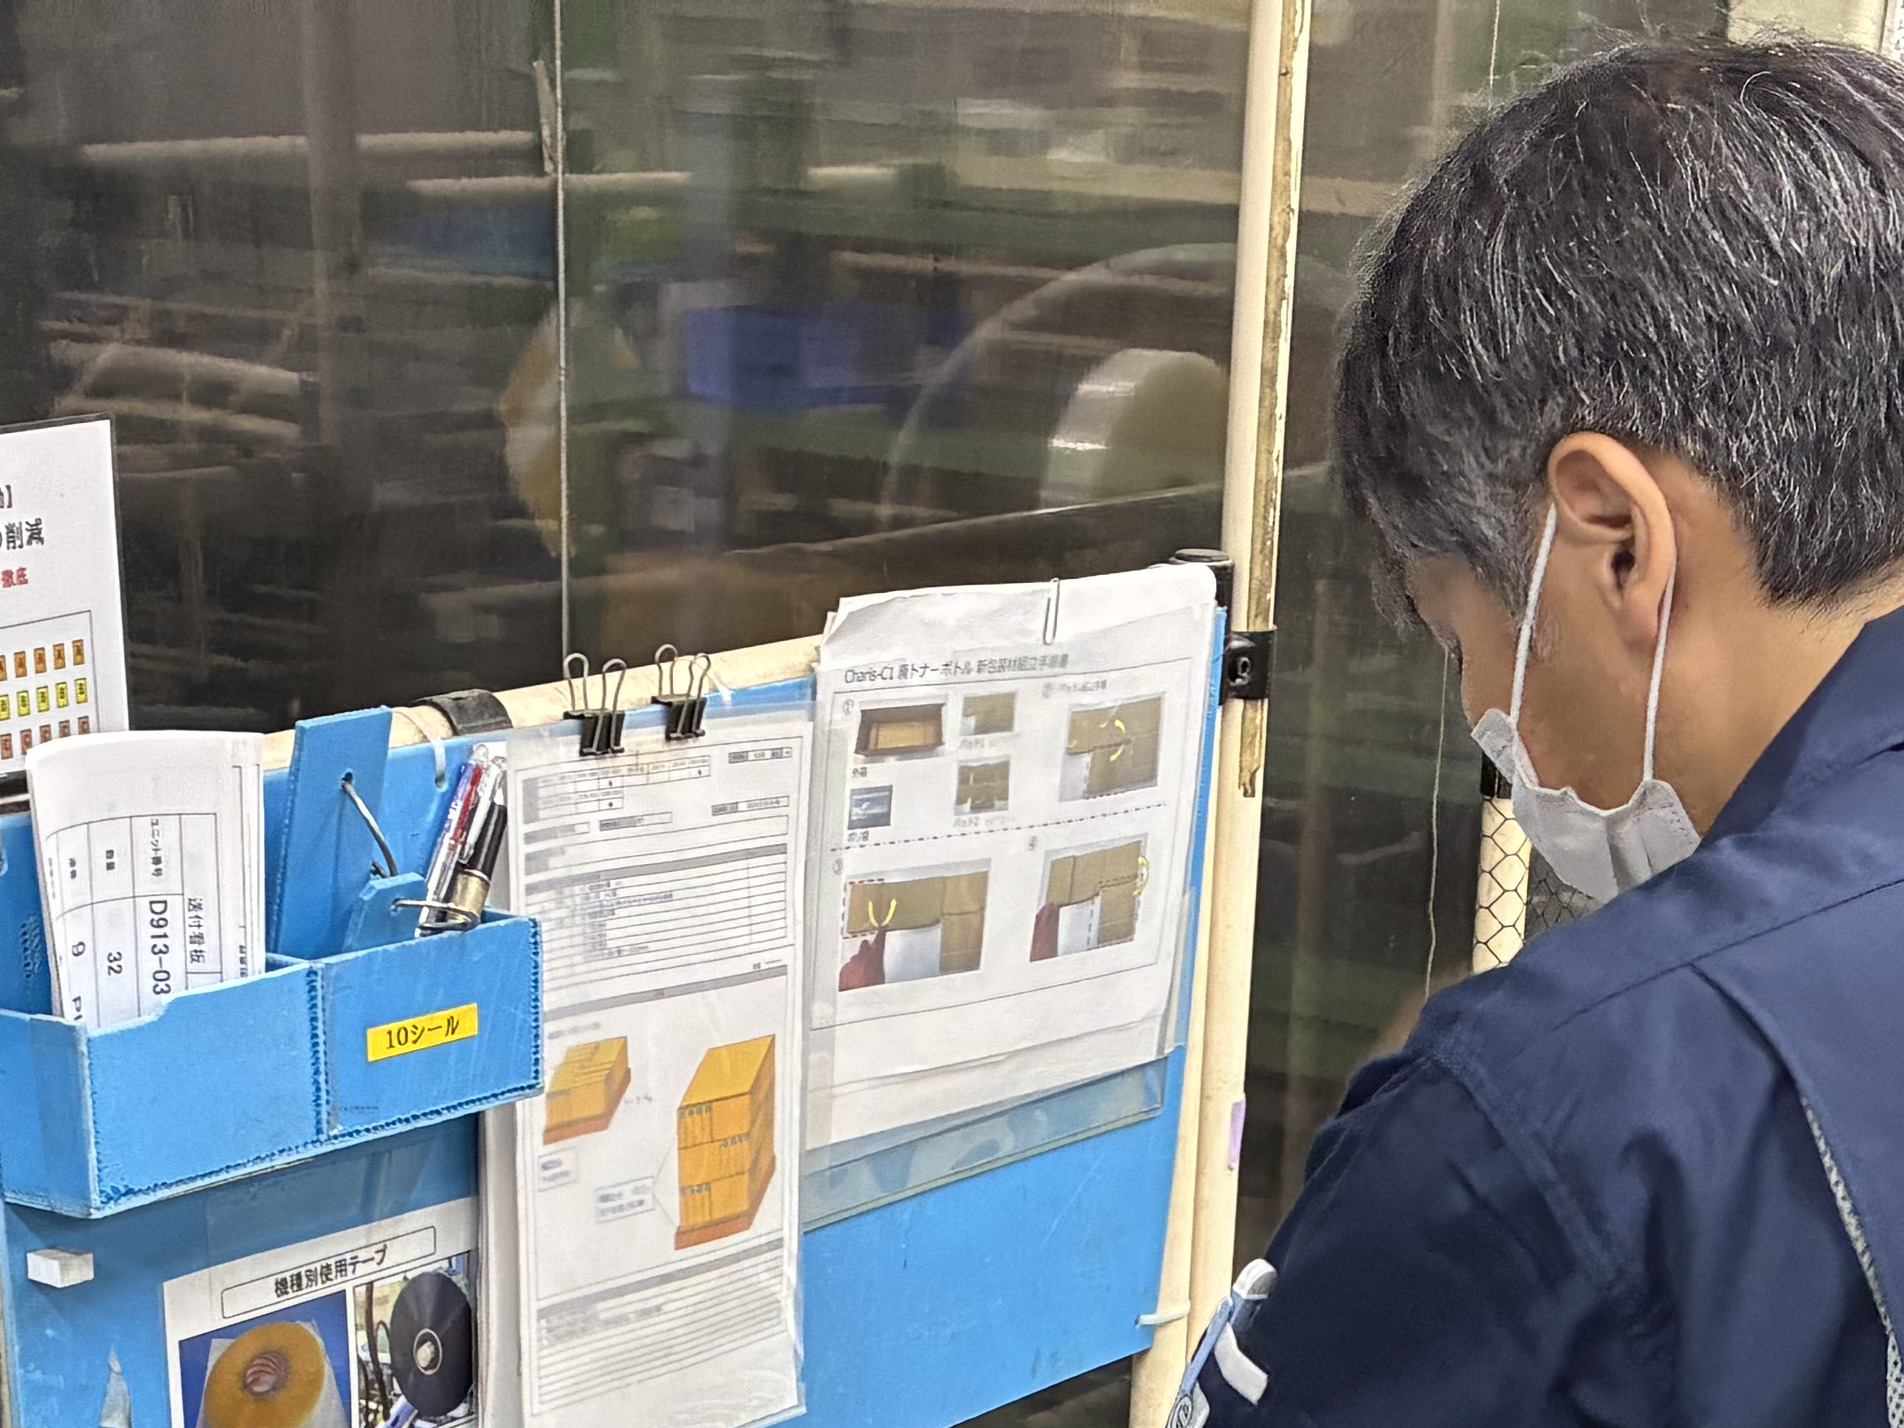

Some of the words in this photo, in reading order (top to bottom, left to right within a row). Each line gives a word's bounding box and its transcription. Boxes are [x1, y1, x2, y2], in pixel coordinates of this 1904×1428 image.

[107, 951, 123, 976] 32
[149, 899, 172, 995] D913-03
[273, 1245, 387, 1299] 機種別使用テープ
